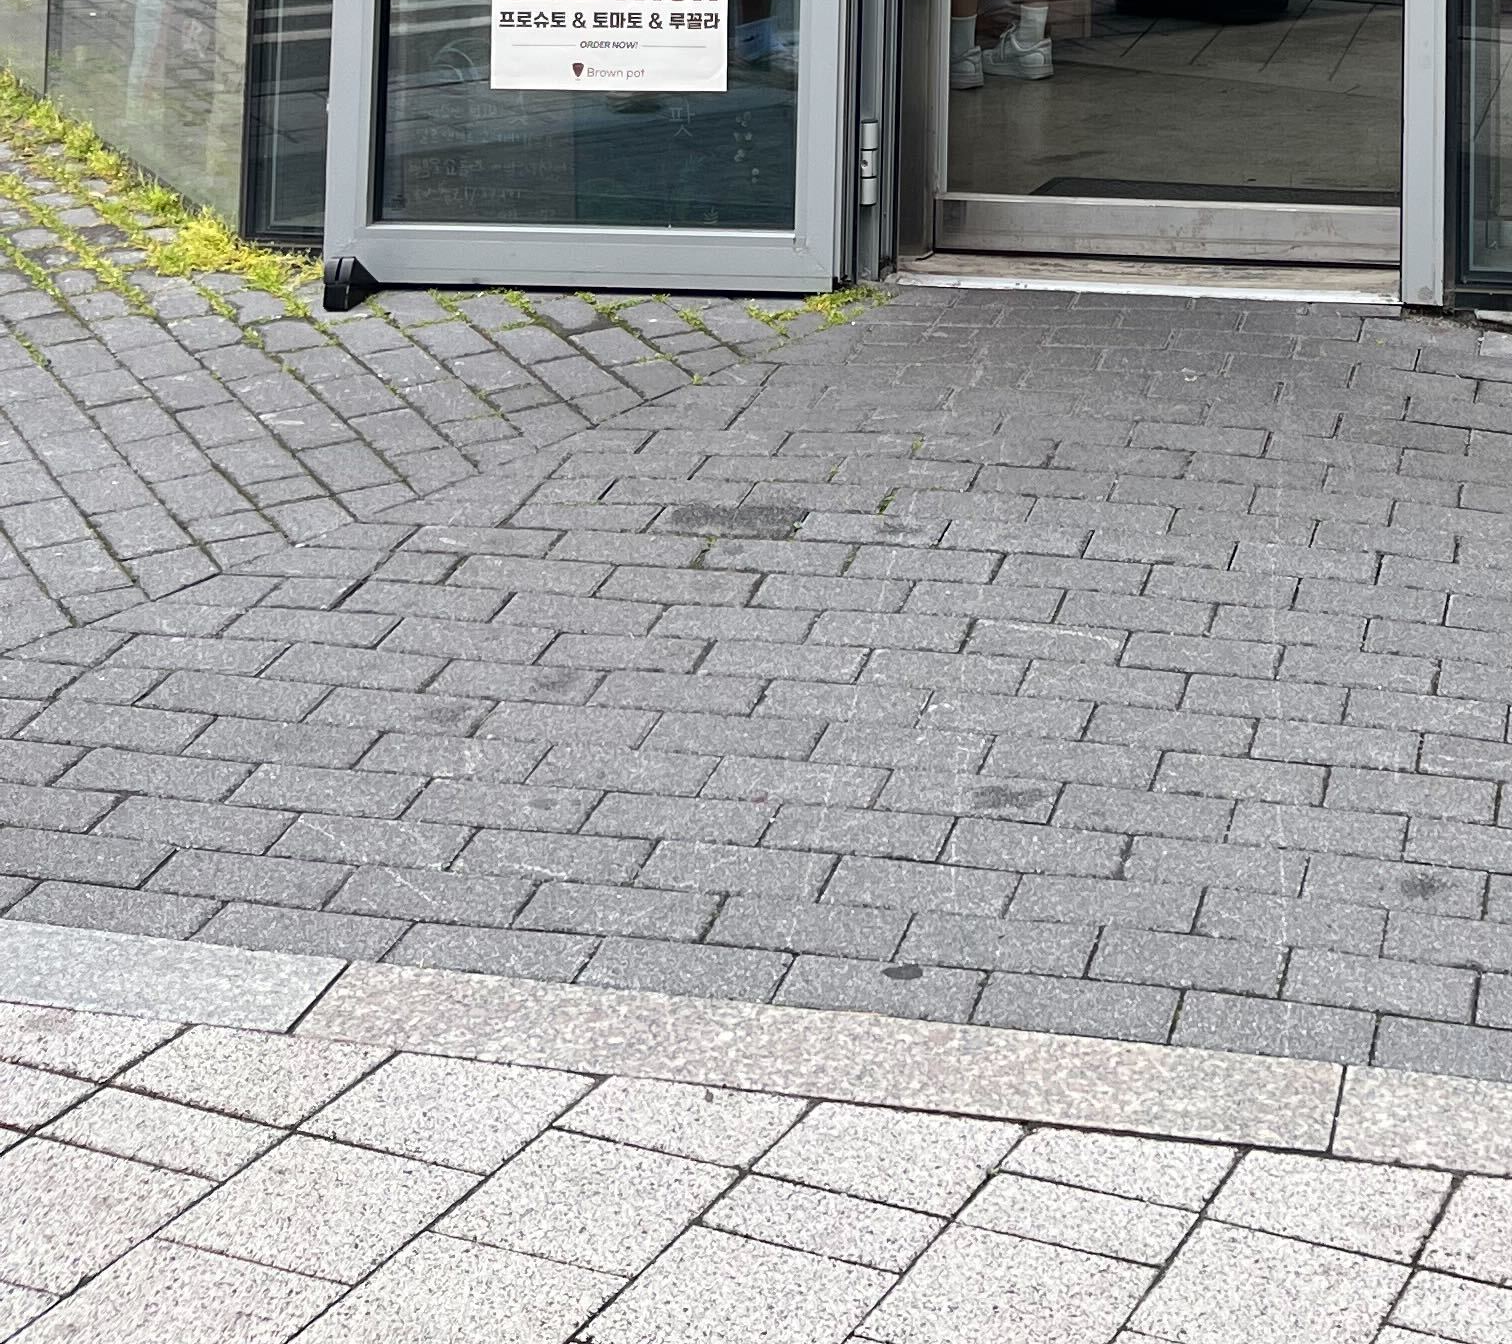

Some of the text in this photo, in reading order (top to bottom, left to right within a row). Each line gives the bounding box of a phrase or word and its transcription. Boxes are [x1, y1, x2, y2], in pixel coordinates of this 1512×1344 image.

[499, 11, 720, 30] 프로슈토 & 토마토 & 루꼴라
[580, 41, 639, 50] ORDER NOW!
[587, 67, 645, 80] Brown pot
